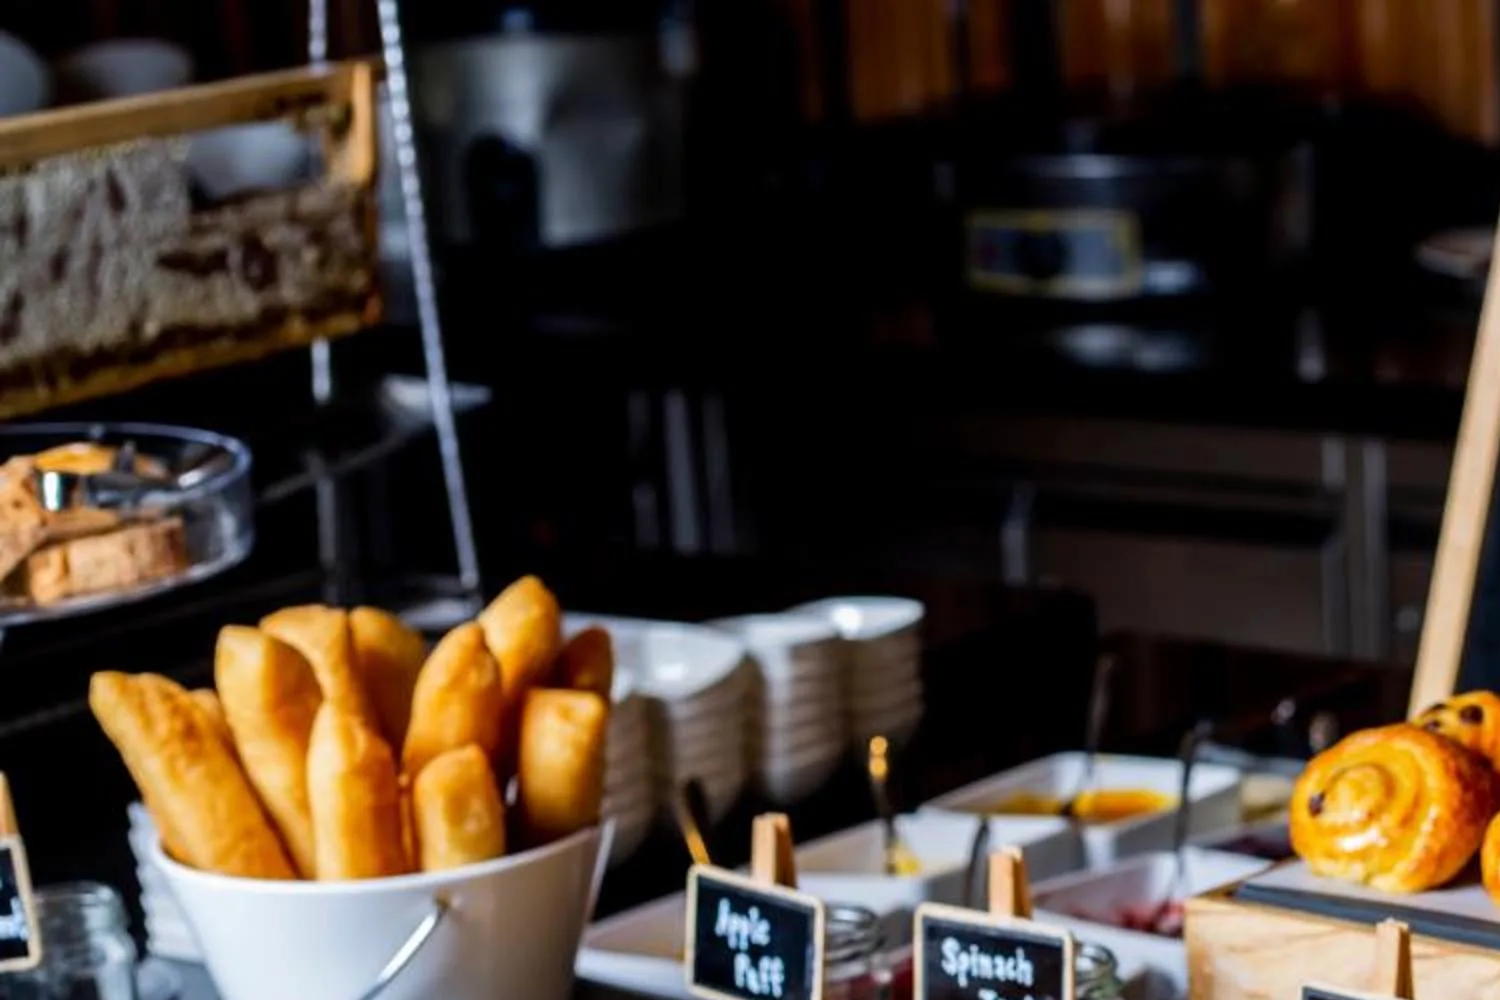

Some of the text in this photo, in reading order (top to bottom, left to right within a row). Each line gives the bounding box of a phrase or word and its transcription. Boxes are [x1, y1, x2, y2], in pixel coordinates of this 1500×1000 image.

[715, 898, 771, 951] Apple
[734, 952, 785, 998] Puff
[941, 937, 1033, 987] Spinach
